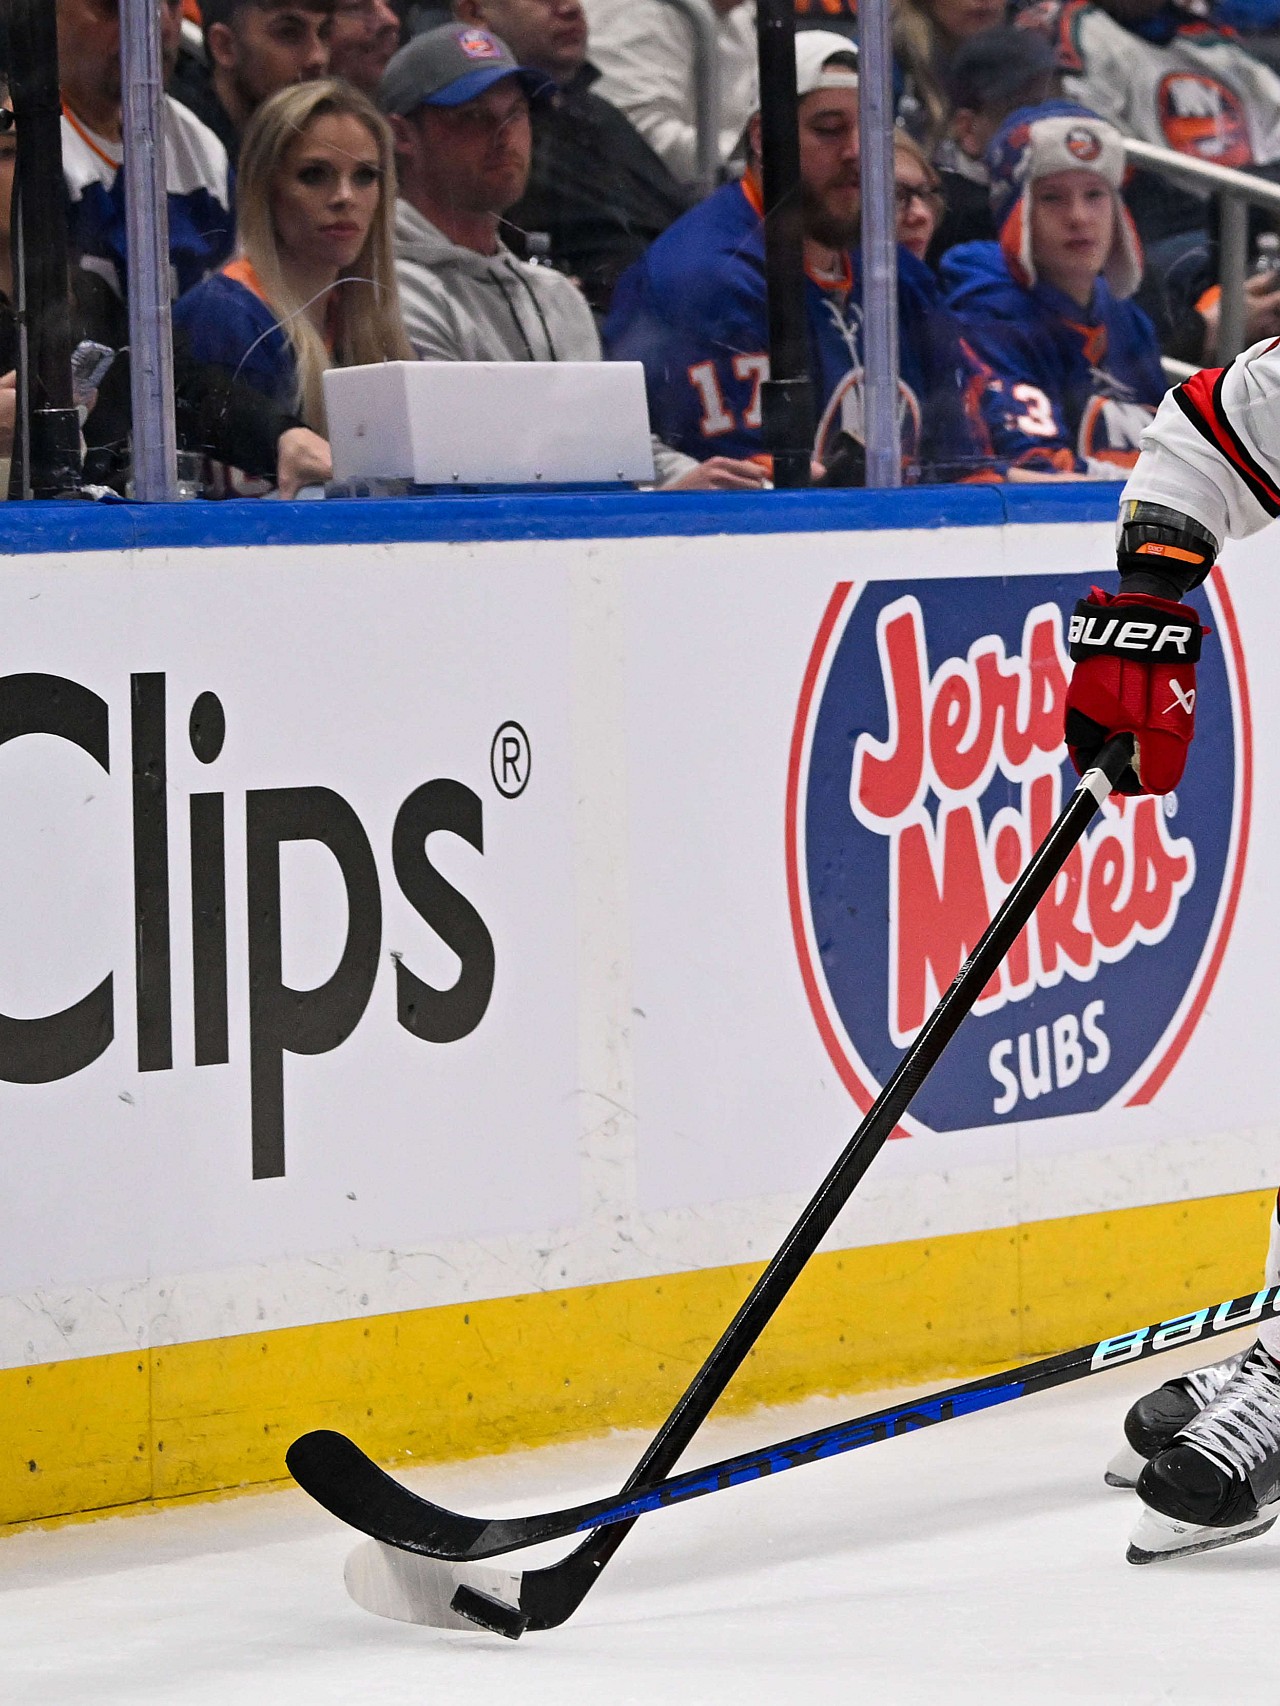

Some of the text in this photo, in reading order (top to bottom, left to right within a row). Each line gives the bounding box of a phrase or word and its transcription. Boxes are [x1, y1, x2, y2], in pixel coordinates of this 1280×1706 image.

[687, 352, 771, 438] 17
[1068, 615, 1192, 655] AUER
[853, 600, 1070, 826] Jers
[988, 999, 1112, 1115] SUBS
